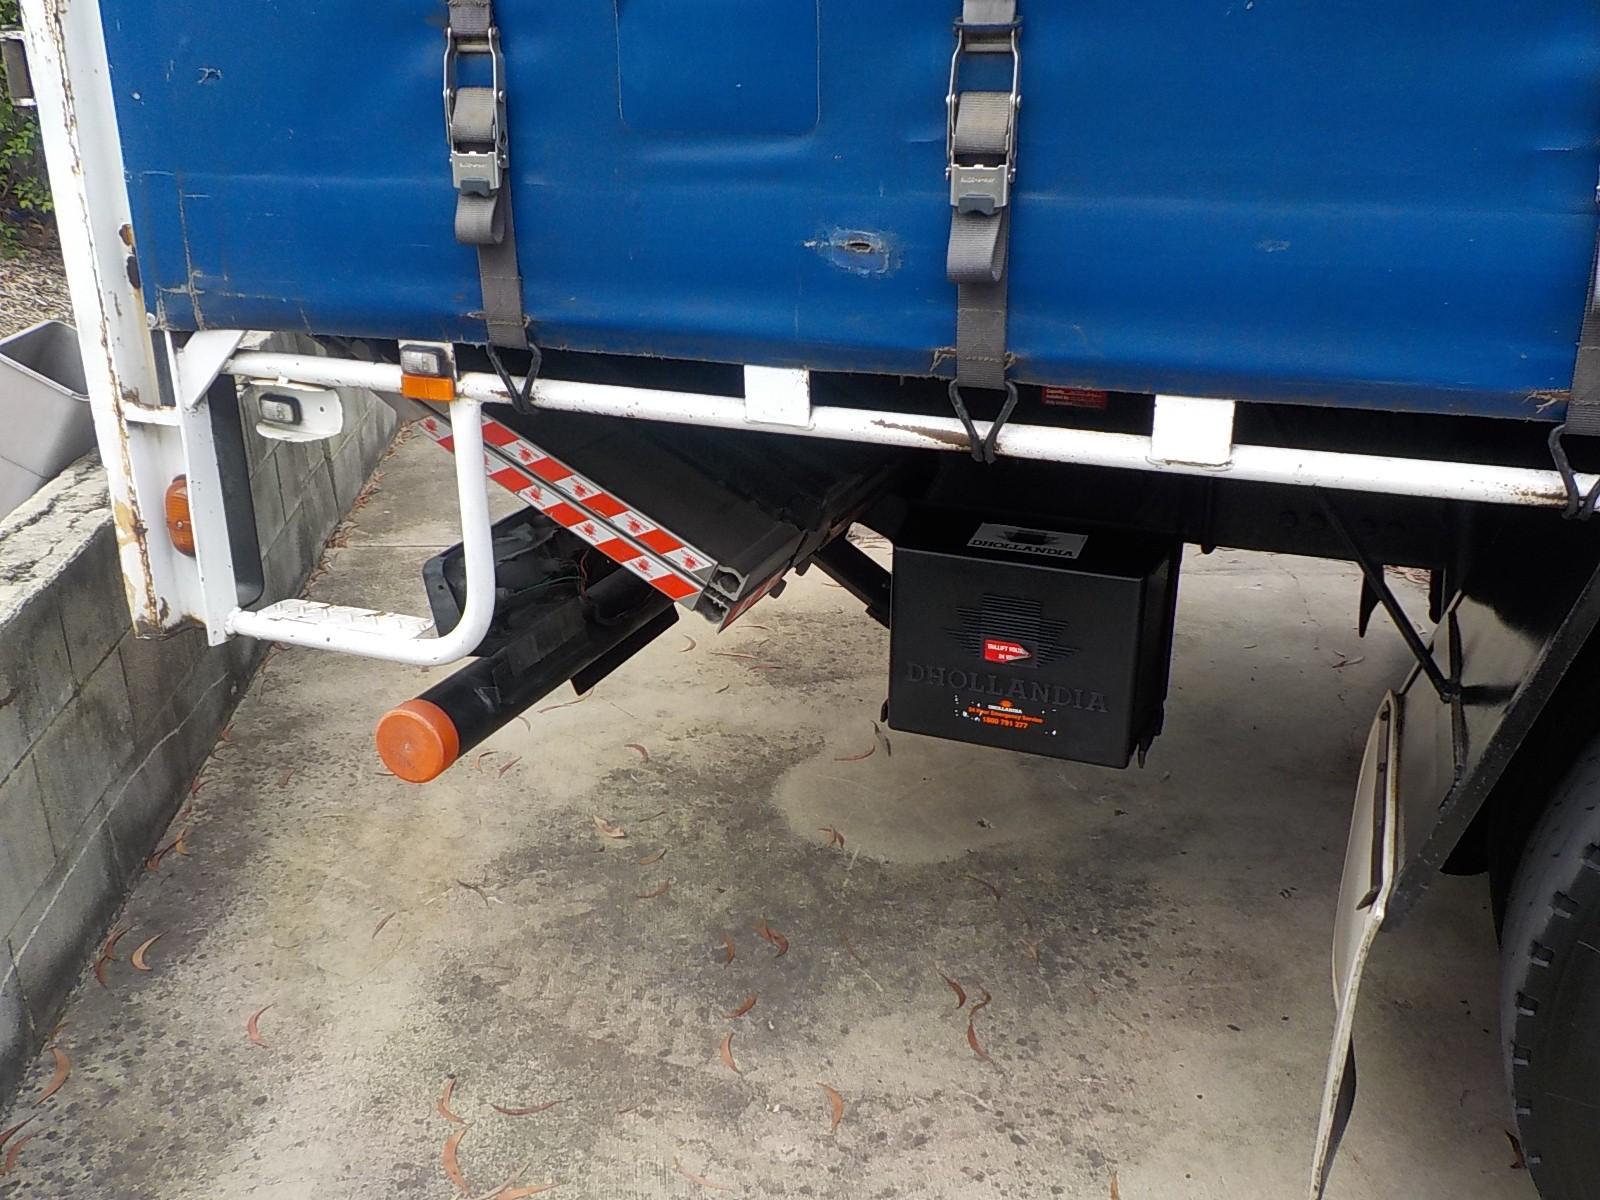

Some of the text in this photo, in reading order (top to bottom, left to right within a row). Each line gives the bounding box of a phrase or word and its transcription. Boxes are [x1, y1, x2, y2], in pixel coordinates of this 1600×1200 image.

[970, 539, 1074, 557] DHOLLANDIA
[906, 663, 1109, 712] DHOLLANDIA
[990, 709, 1022, 720] Emergency
[1022, 715, 1043, 724] Service
